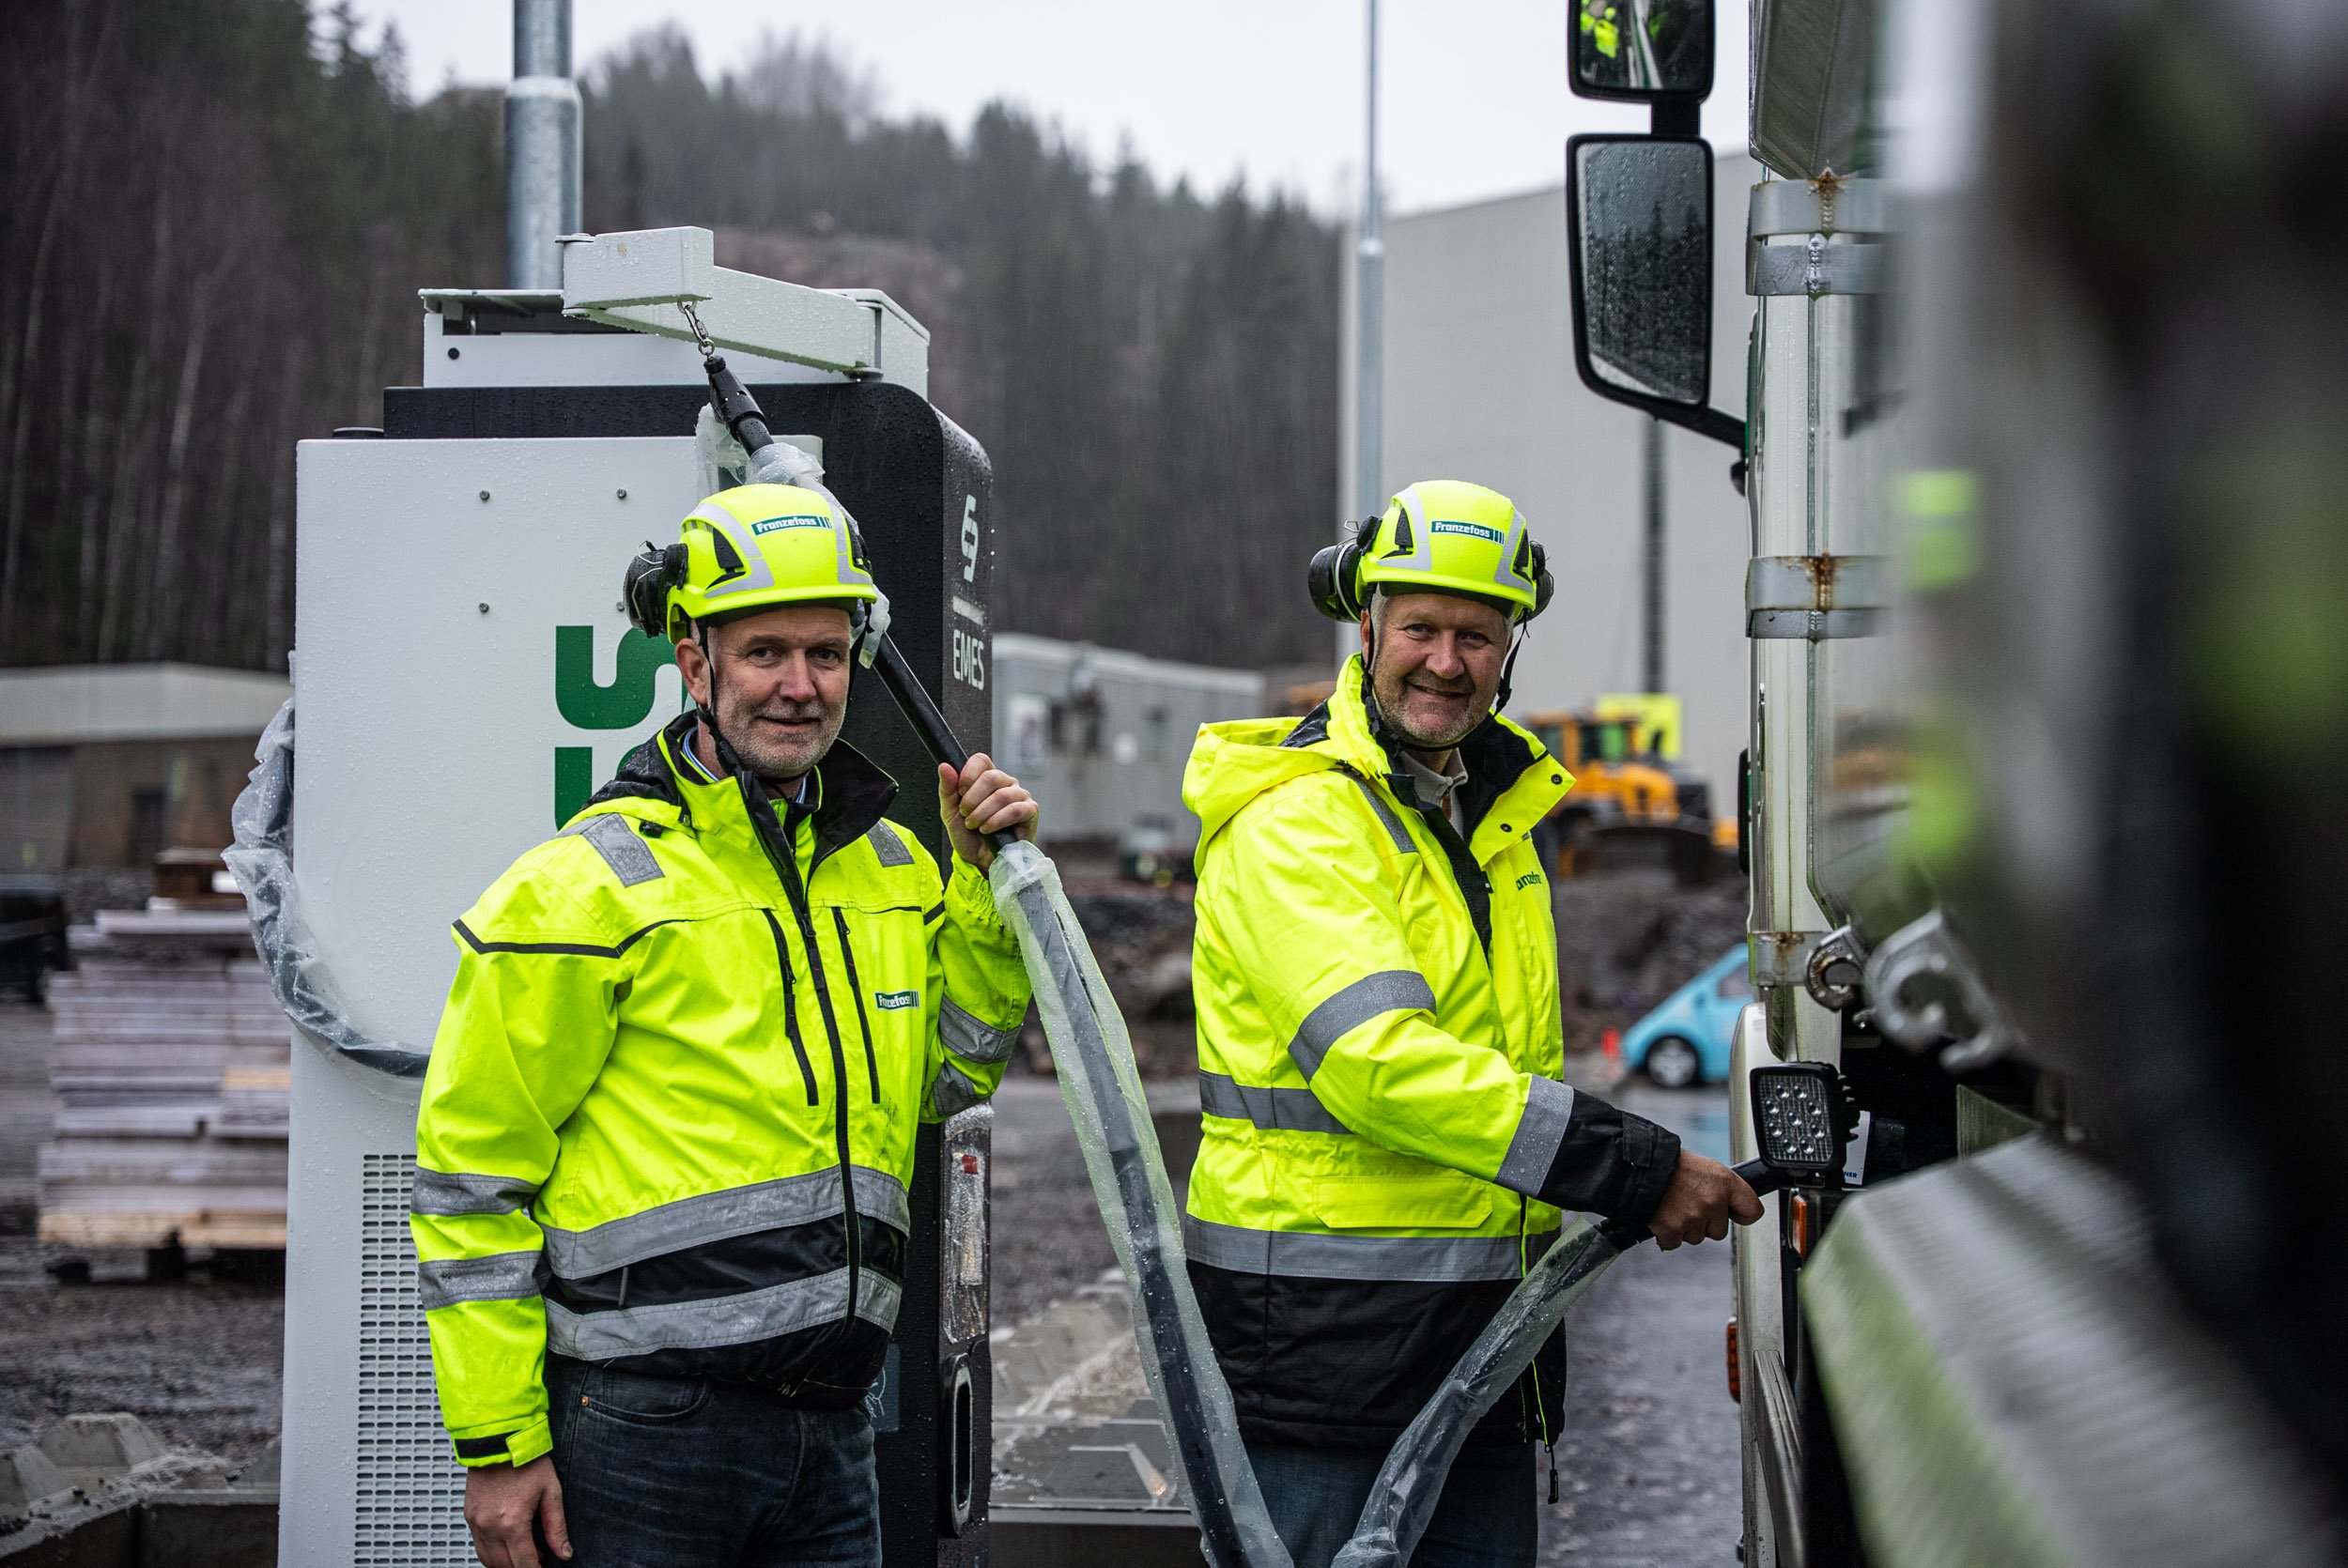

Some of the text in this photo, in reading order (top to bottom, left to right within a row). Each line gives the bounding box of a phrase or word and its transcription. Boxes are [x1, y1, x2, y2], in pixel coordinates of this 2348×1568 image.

[755, 517, 817, 533] Franzefoss
[1434, 521, 1491, 538] Franzefoss
[952, 628, 985, 692] EMES
